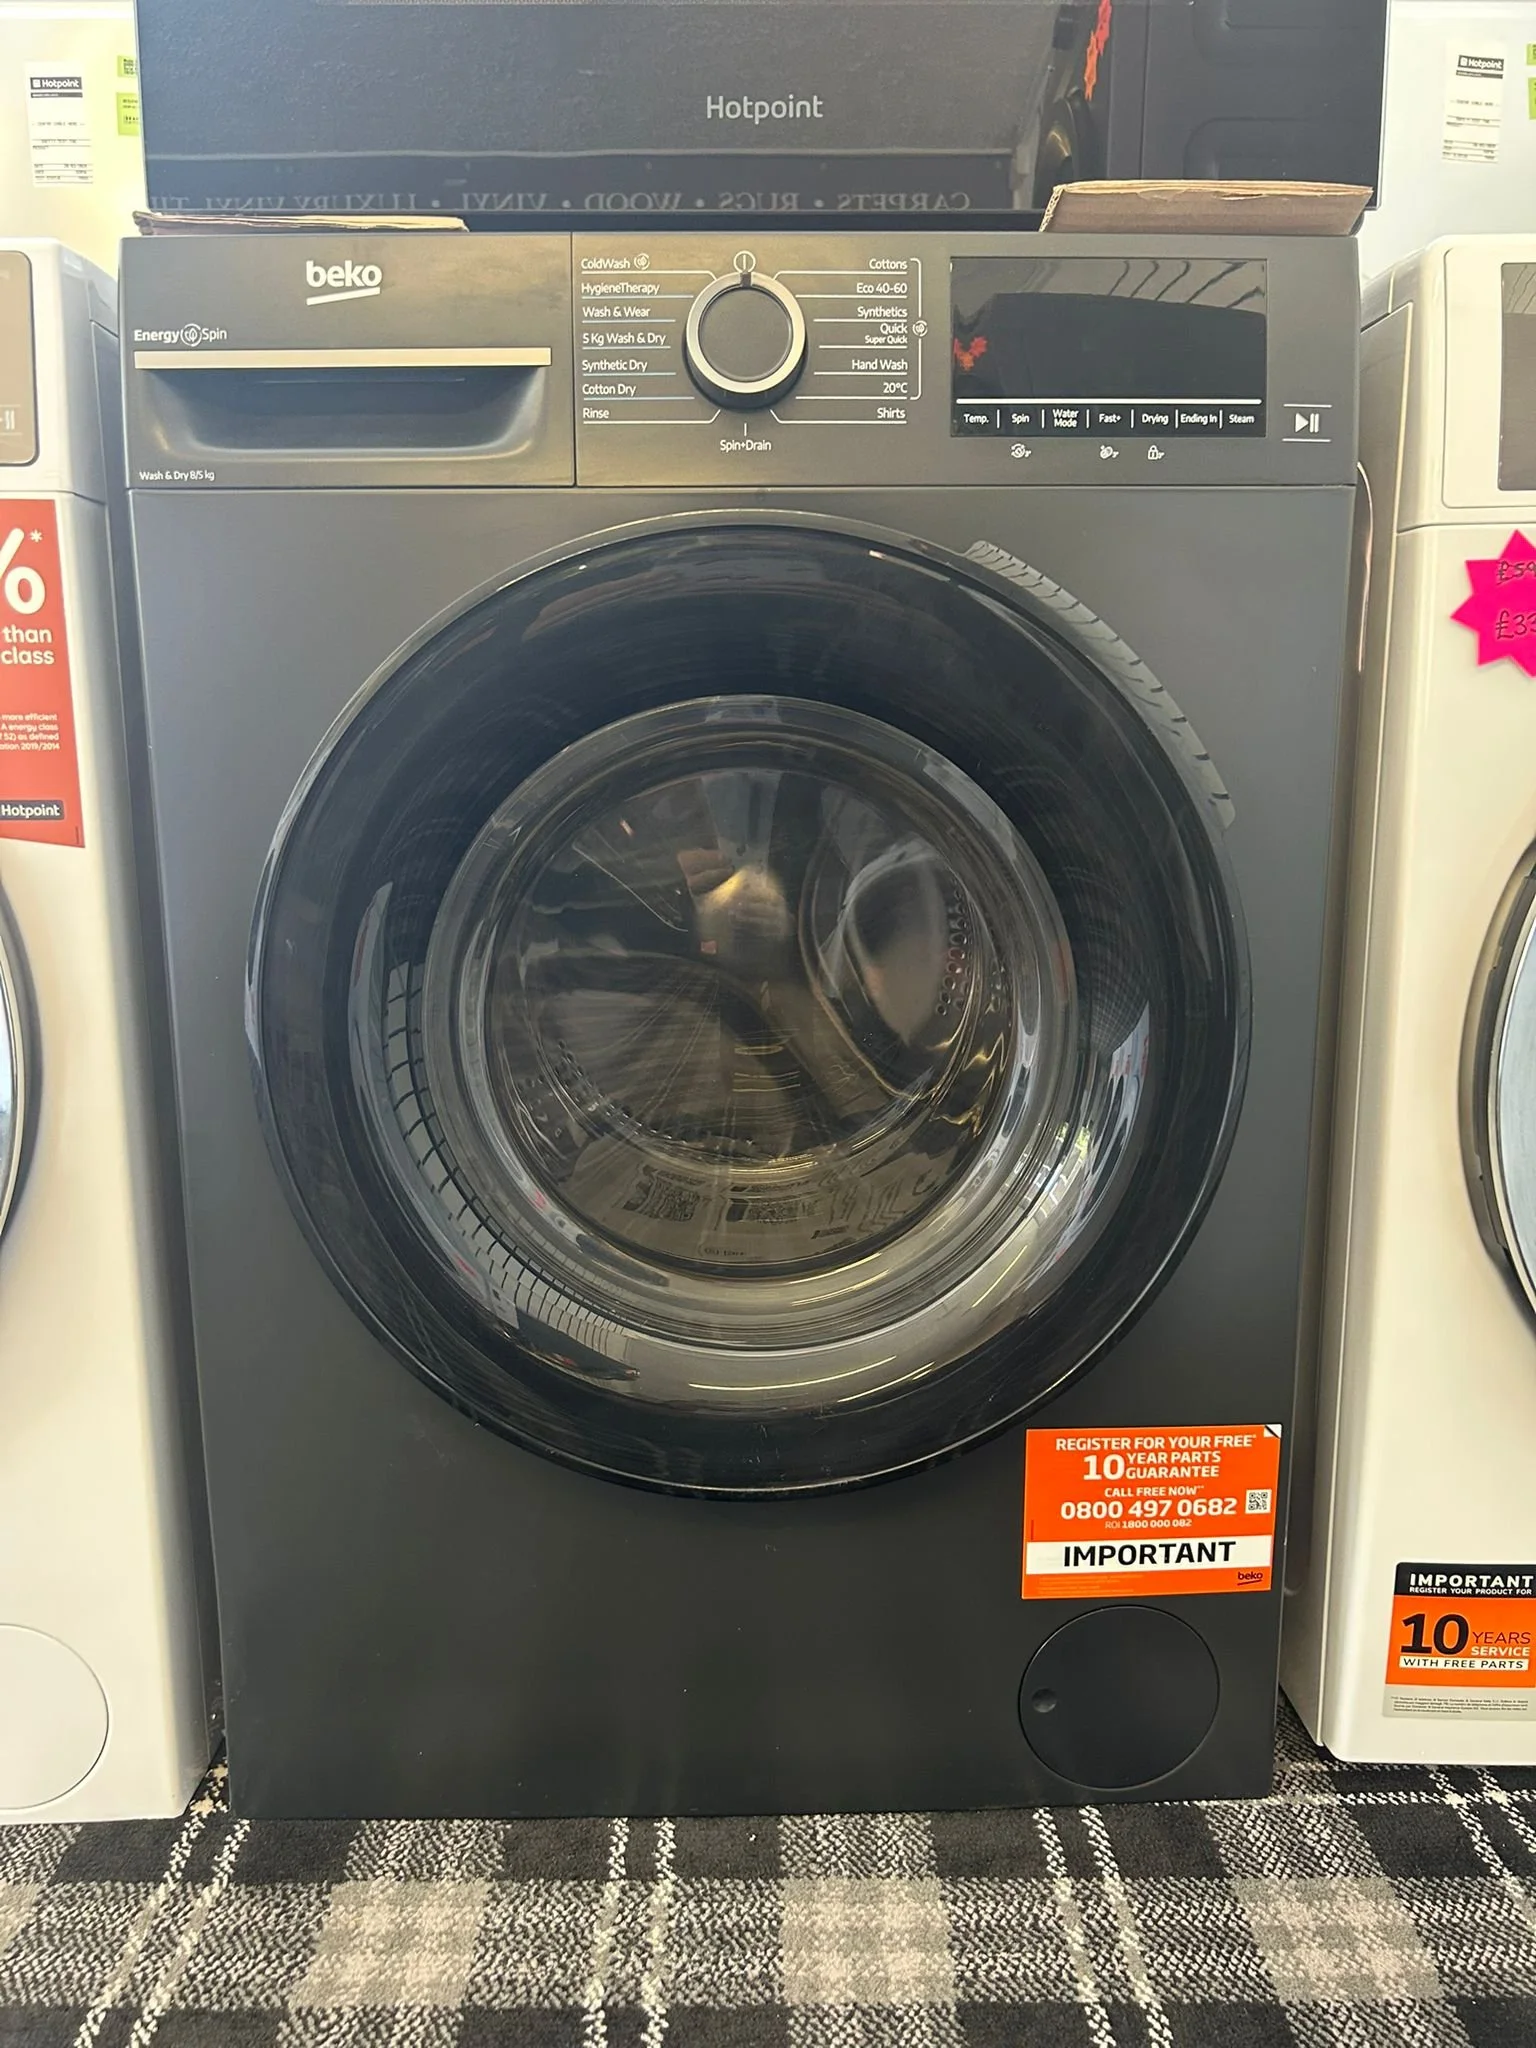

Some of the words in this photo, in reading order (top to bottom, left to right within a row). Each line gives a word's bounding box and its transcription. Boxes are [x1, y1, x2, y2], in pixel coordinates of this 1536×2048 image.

[1468, 57, 1503, 69] Hotpoint
[41, 79, 80, 89] Hotpoint
[706, 95, 823, 124] Hotpoint
[581, 258, 630, 269] ColdWash
[869, 259, 907, 270] Cottons
[306, 260, 382, 288] beko
[581, 282, 660, 295] HygieneTherapy
[857, 283, 874, 294] Eco
[876, 283, 907, 294] 40-60
[582, 307, 611, 318] Wash
[613, 307, 622, 317] &
[624, 306, 650, 317] Wear
[857, 306, 907, 319] Synthetics
[134, 329, 180, 343] Energy
[202, 327, 227, 342] Spin
[880, 323, 907, 335] Quick
[582, 333, 589, 344] 5
[591, 333, 604, 346] Kg
[606, 333, 635, 344] Wash
[636, 333, 646, 344] &
[647, 332, 666, 346] Dry
[865, 335, 885, 345] Super
[887, 335, 907, 345] Quick
[582, 360, 628, 373] Synthetic
[629, 360, 648, 373] Dry
[851, 360, 878, 371] Hand
[879, 360, 908, 371] Wash
[582, 384, 616, 395] Cotton
[618, 384, 637, 397] Dry
[583, 408, 610, 419] Rinse
[876, 408, 906, 419] Shirts
[963, 413, 990, 425] Temp.
[1011, 413, 1030, 425] Spin
[1052, 408, 1079, 418] Water
[1098, 413, 1122, 424] Fast+
[1141, 413, 1169, 425] Drying
[1180, 413, 1208, 425] Ending
[1209, 413, 1218, 423] In
[1228, 413, 1255, 424] Steam
[1053, 418, 1078, 428] Mode
[719, 440, 772, 453] Spin+Drain
[139, 471, 164, 481] Wash
[165, 471, 172, 480] &
[173, 471, 190, 482] Dry
[190, 471, 203, 481] 8/5
[204, 470, 215, 482] kg
[3, 624, 53, 644] than
[0, 646, 55, 665] class
[1, 804, 60, 819] Hotpoint
[1055, 1437, 1131, 1451] REGISTER
[1134, 1436, 1164, 1449] FOR
[1169, 1435, 1211, 1449] YOUR
[1083, 1453, 1125, 1480] 10
[1126, 1452, 1168, 1464] YEAR
[1171, 1451, 1221, 1463] PARTS
[1125, 1465, 1220, 1479] GUARANTEE
[1104, 1487, 1134, 1497] CALL
[1136, 1486, 1166, 1497] FREE
[1061, 1501, 1123, 1519] 0800
[1128, 1500, 1172, 1518] 497
[1177, 1498, 1237, 1517] 0682
[1105, 1520, 1120, 1529] ROI
[1122, 1520, 1148, 1529] 1800
[1149, 1519, 1171, 1528] 000
[1172, 1518, 1192, 1528] 082
[1063, 1541, 1236, 1567] IMPORTANT
[1237, 1571, 1263, 1581] beko
[1410, 1574, 1533, 1588] IMPORTANT
[1401, 1613, 1469, 1655] 10
[1472, 1631, 1531, 1645] YEARS
[1471, 1646, 1531, 1657] SERVICE
[1403, 1658, 1439, 1667] WITH
[1444, 1659, 1476, 1668] FREE
[1481, 1660, 1524, 1669] PARTS
